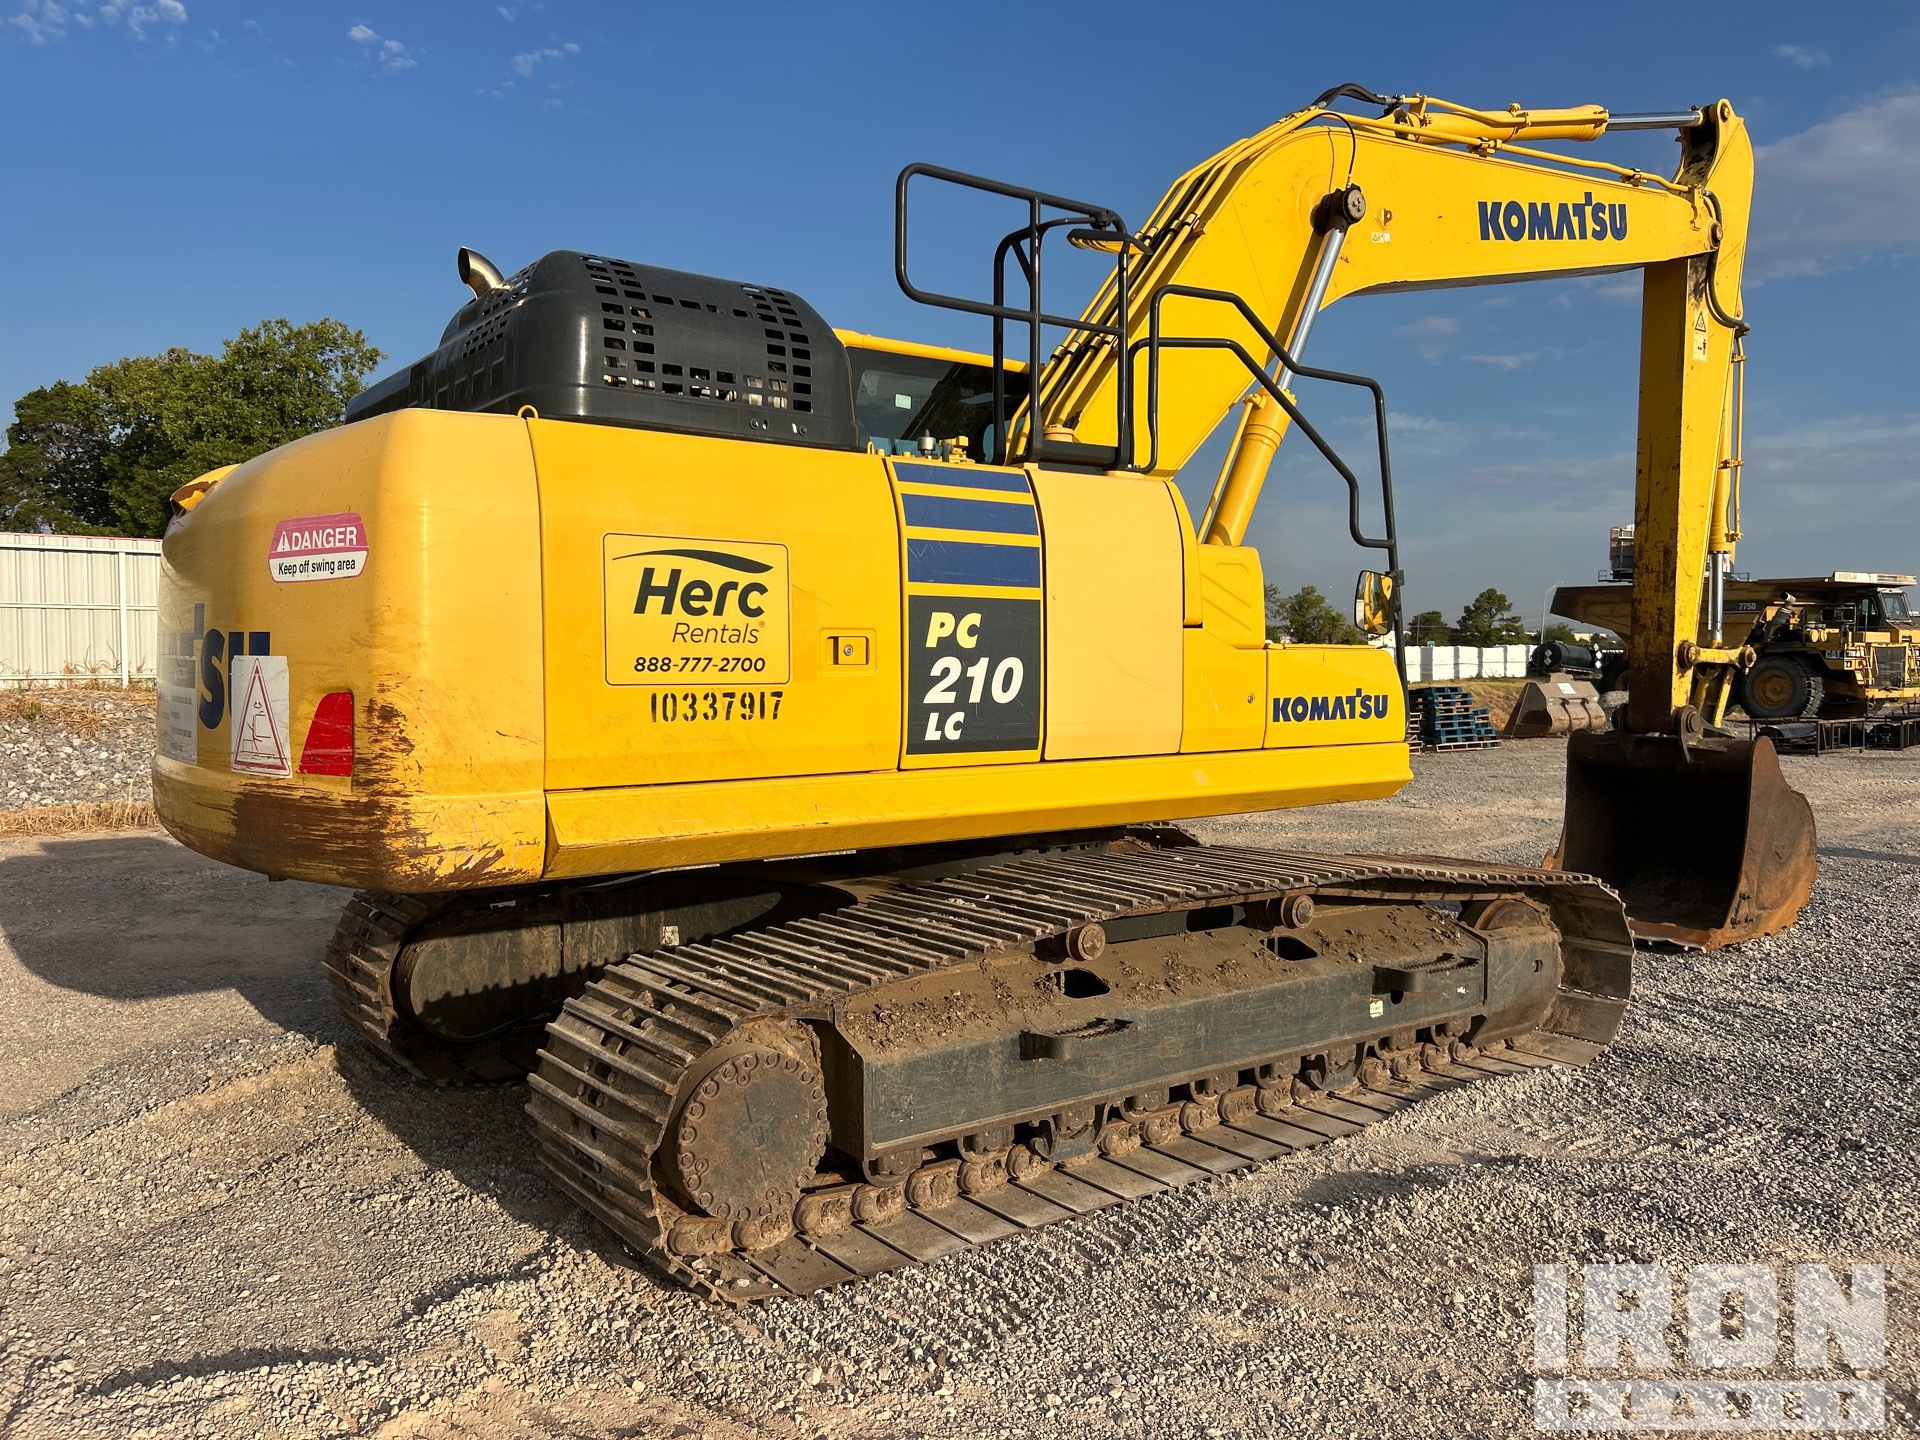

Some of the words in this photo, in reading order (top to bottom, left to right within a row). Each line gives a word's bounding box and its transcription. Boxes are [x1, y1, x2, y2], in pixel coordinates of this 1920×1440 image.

[1477, 191, 1628, 242] KOMATSU
[291, 526, 358, 551] DANGER
[278, 561, 298, 577] Keep
[298, 559, 310, 574] off
[311, 558, 336, 575] swing
[337, 559, 356, 571] area
[633, 567, 769, 618] Herc
[925, 611, 982, 649] PC
[633, 656, 766, 673] 888-777-2700
[1825, 649, 1842, 659] CAT
[922, 656, 1024, 704] 210
[650, 691, 784, 723] 10337917
[1272, 687, 1389, 723] KOMATSU
[925, 711, 966, 741] LC
